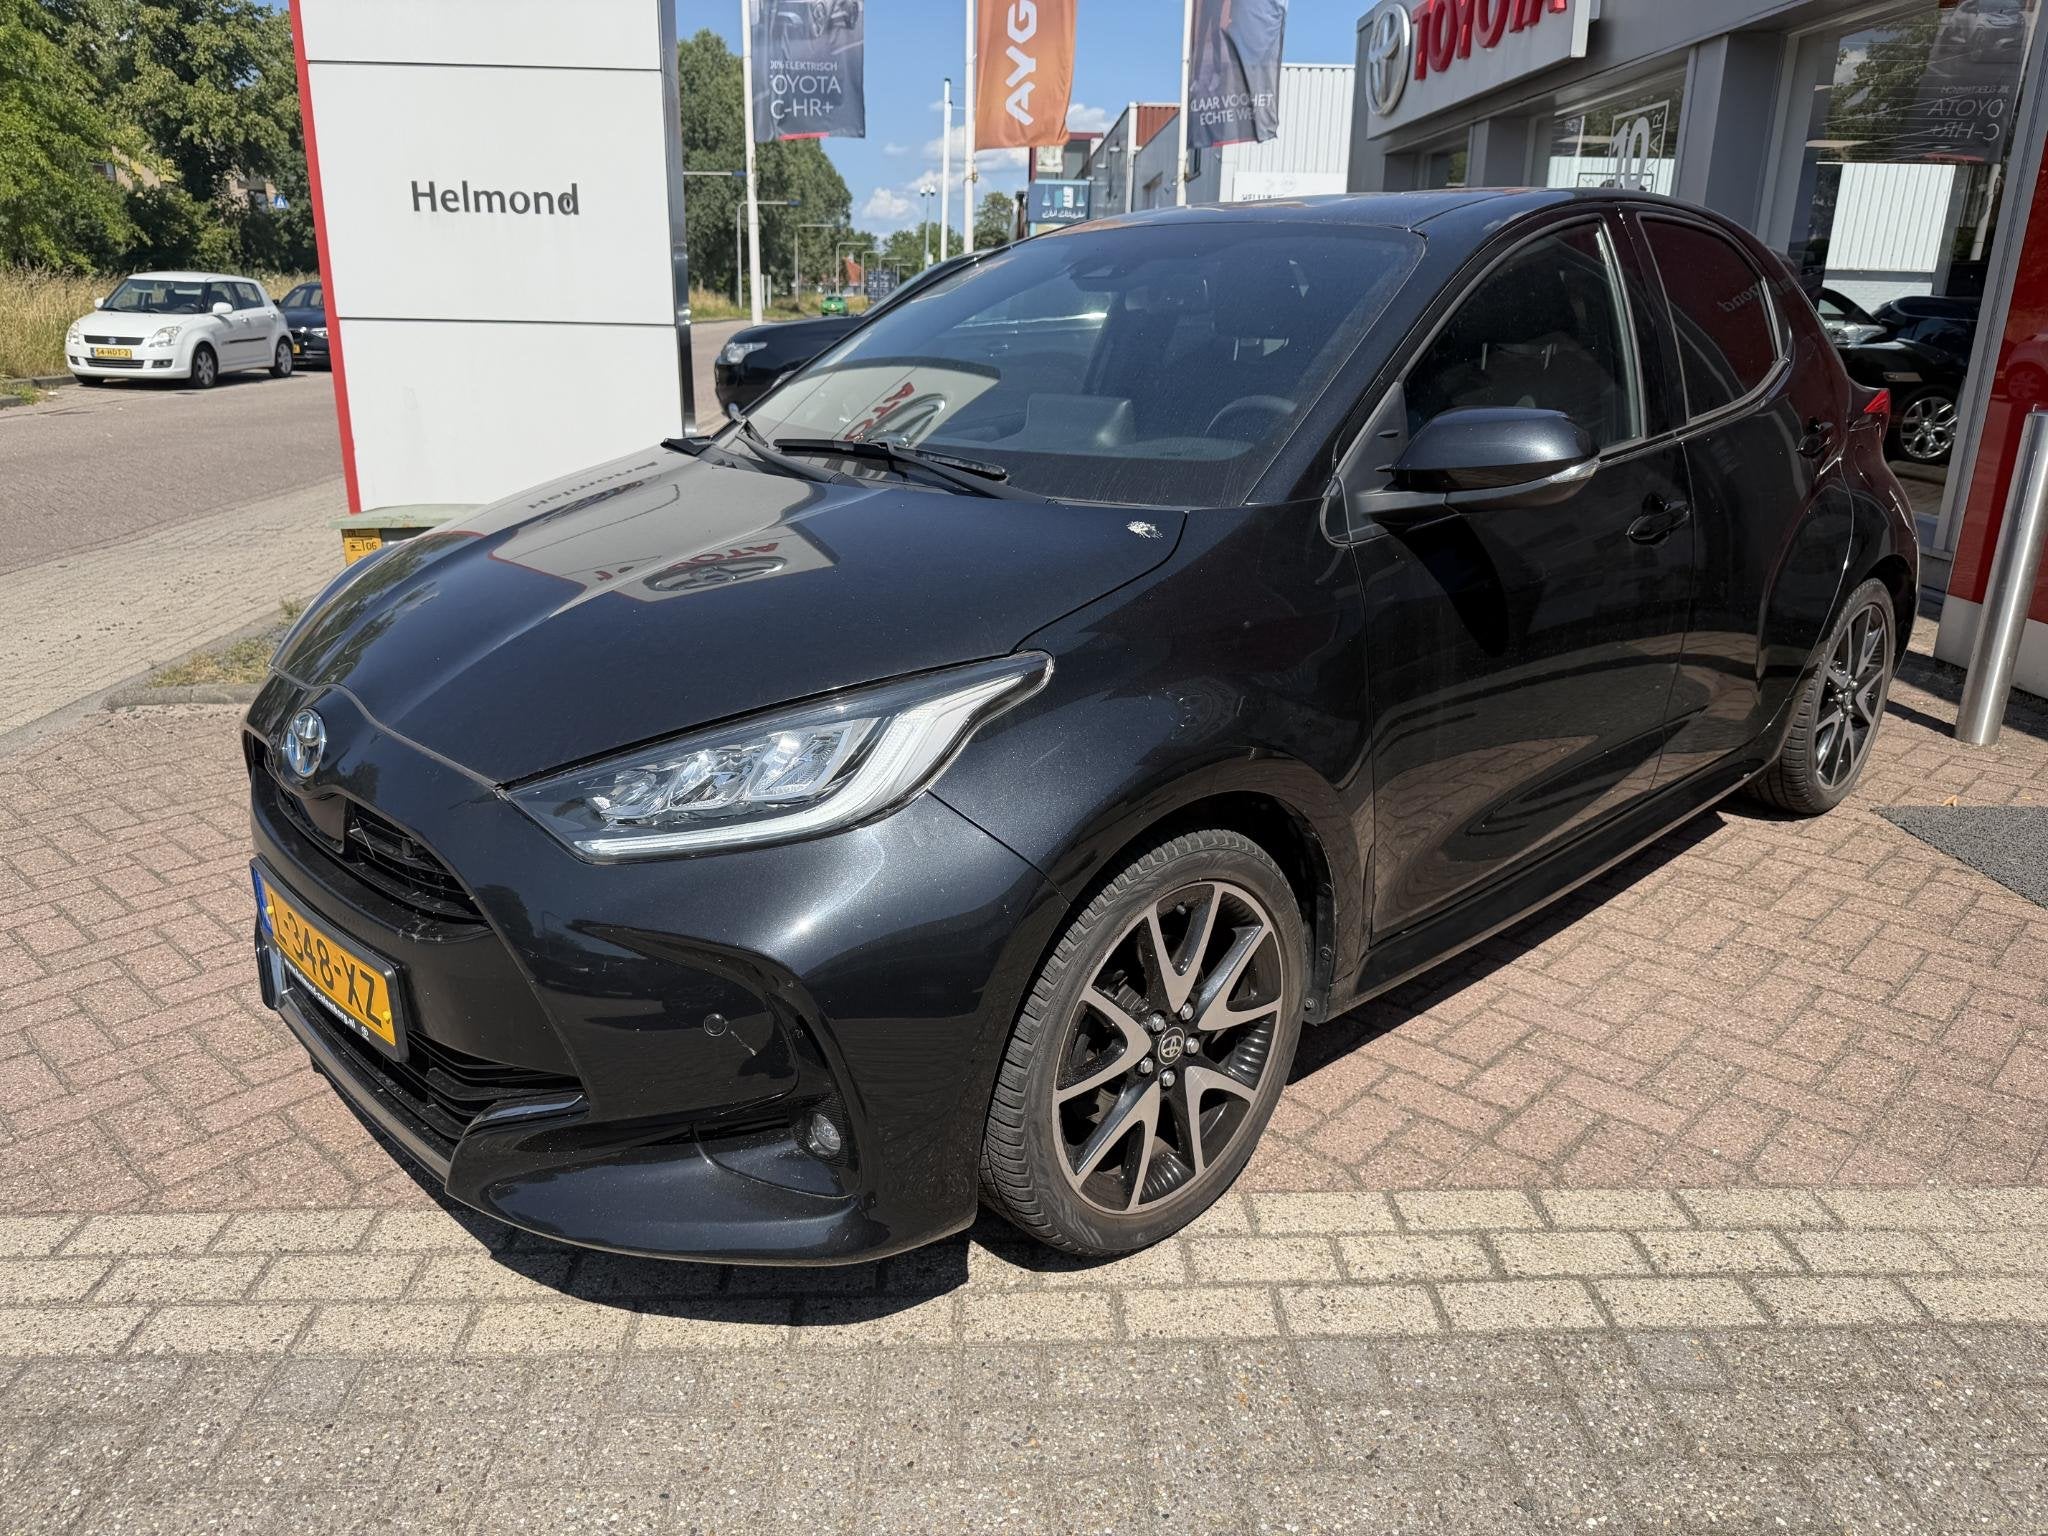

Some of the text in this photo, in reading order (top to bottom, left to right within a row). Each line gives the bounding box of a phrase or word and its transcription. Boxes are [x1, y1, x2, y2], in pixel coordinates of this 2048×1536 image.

[1412, 0, 1567, 81] TOYO
[785, 60, 838, 72] ELEKTRISCH
[770, 74, 841, 94] OYOTA
[770, 98, 834, 119] C-HR+
[1200, 109, 1234, 126] ECHTE
[411, 180, 579, 215] Helmond
[270, 893, 383, 1029] L-348-XZ
